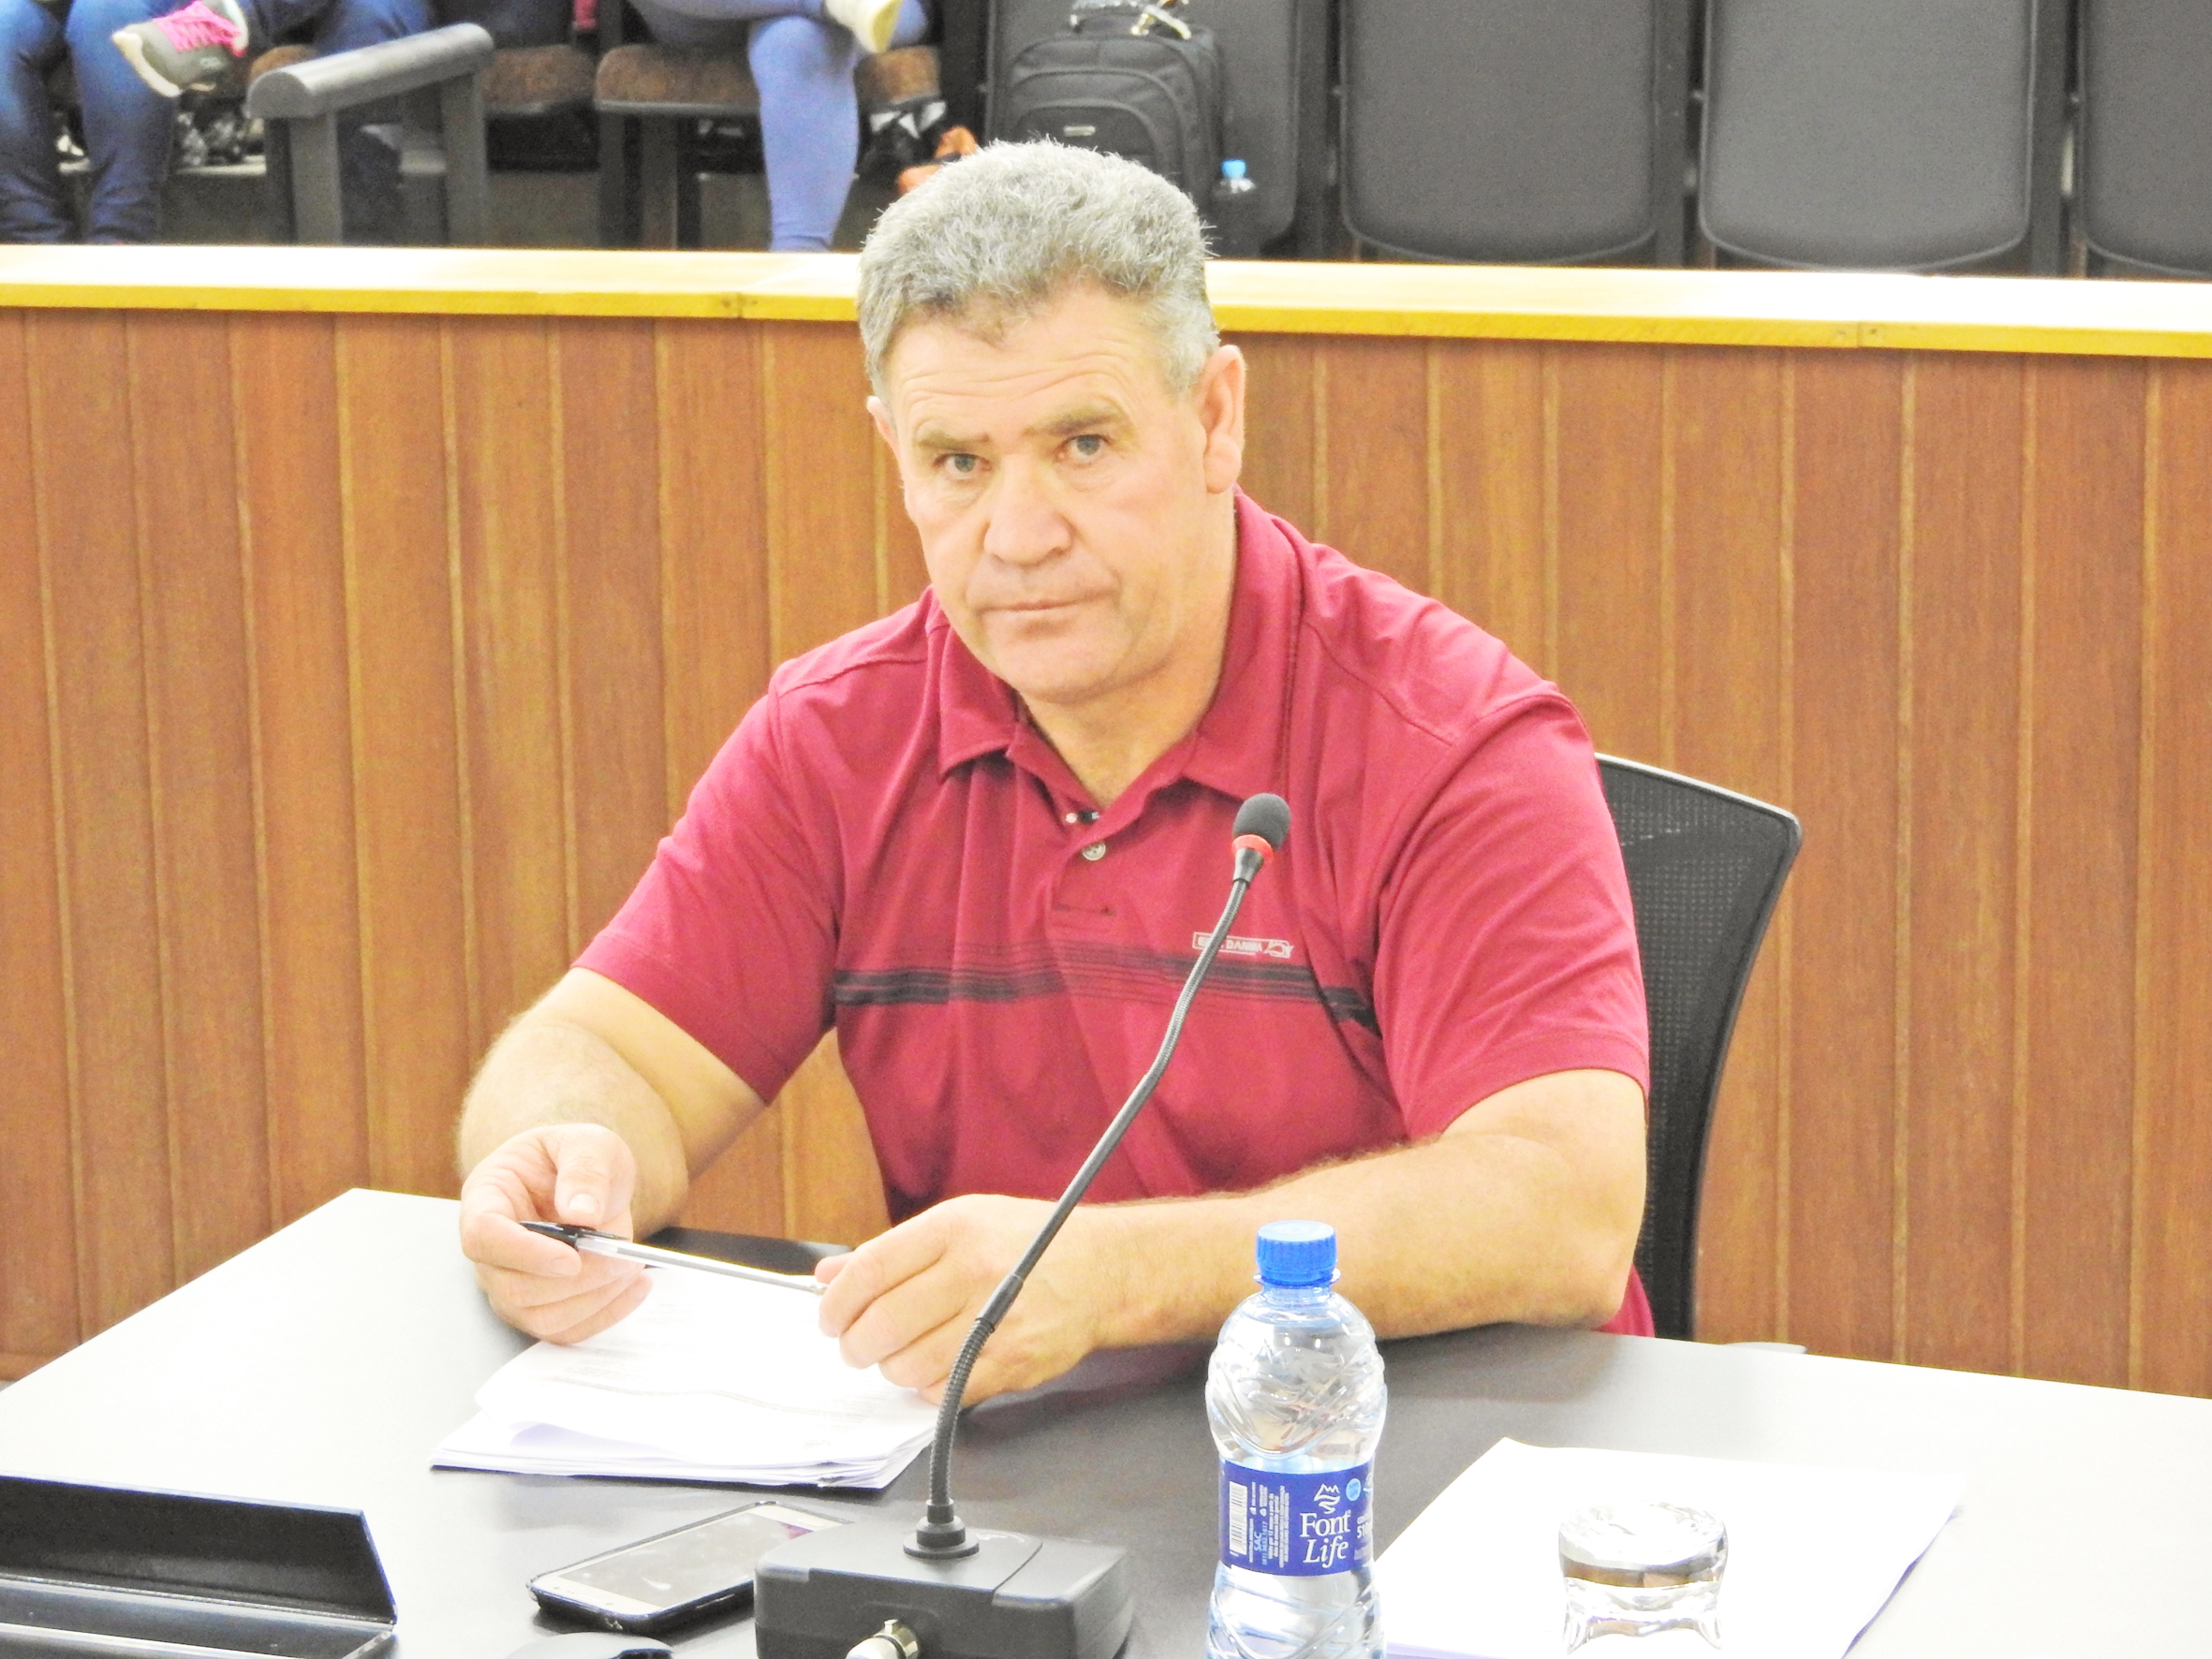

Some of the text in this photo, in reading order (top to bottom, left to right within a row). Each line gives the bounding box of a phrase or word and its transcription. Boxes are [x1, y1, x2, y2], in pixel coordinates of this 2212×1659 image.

[1300, 1512, 1351, 1537] Font
[1253, 1531, 1262, 1552] SAC
[1303, 1535, 1349, 1568] Life
